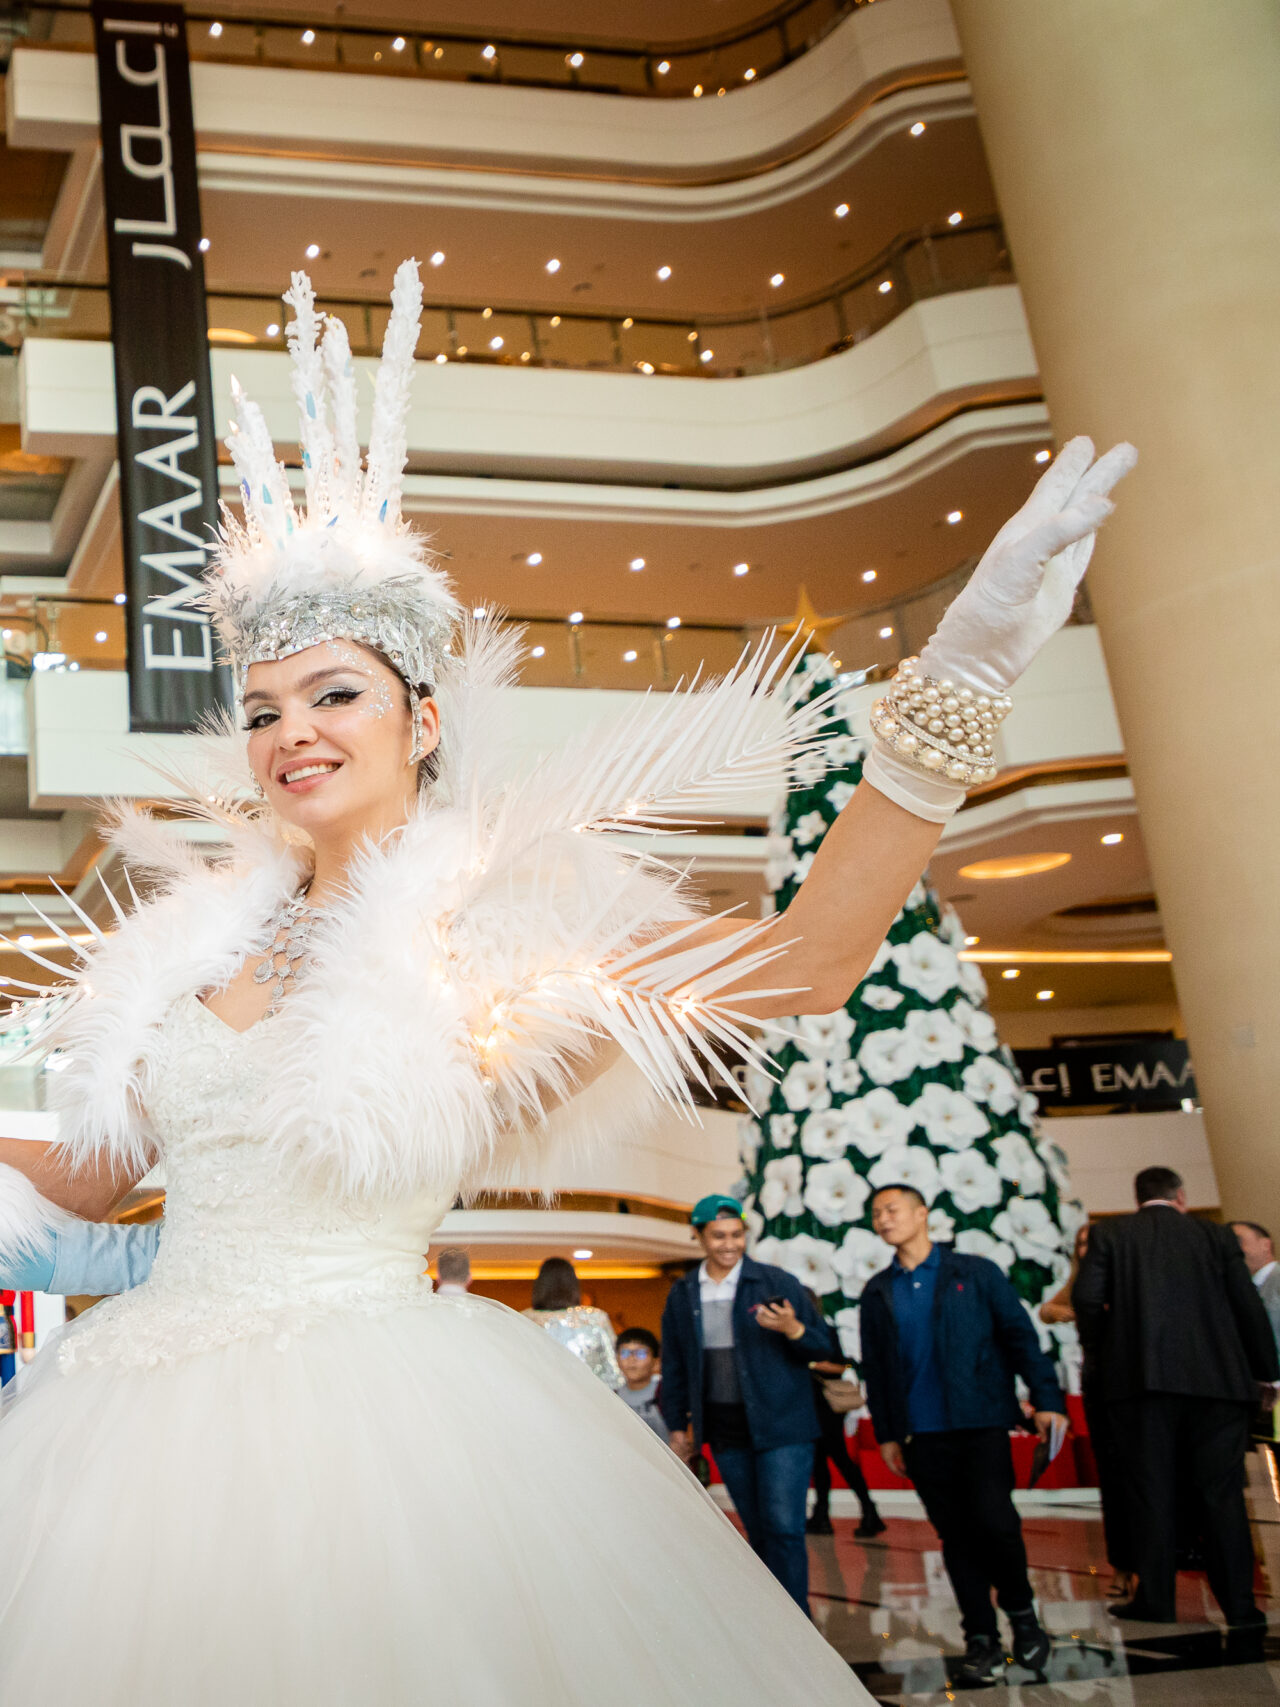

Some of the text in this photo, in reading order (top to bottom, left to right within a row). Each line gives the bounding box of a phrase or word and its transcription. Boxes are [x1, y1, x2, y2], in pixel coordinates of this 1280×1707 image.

[103, 18, 191, 270] إعمار
[131, 380, 213, 672] EMAAR
[1090, 1060, 1197, 1093] EMAA
